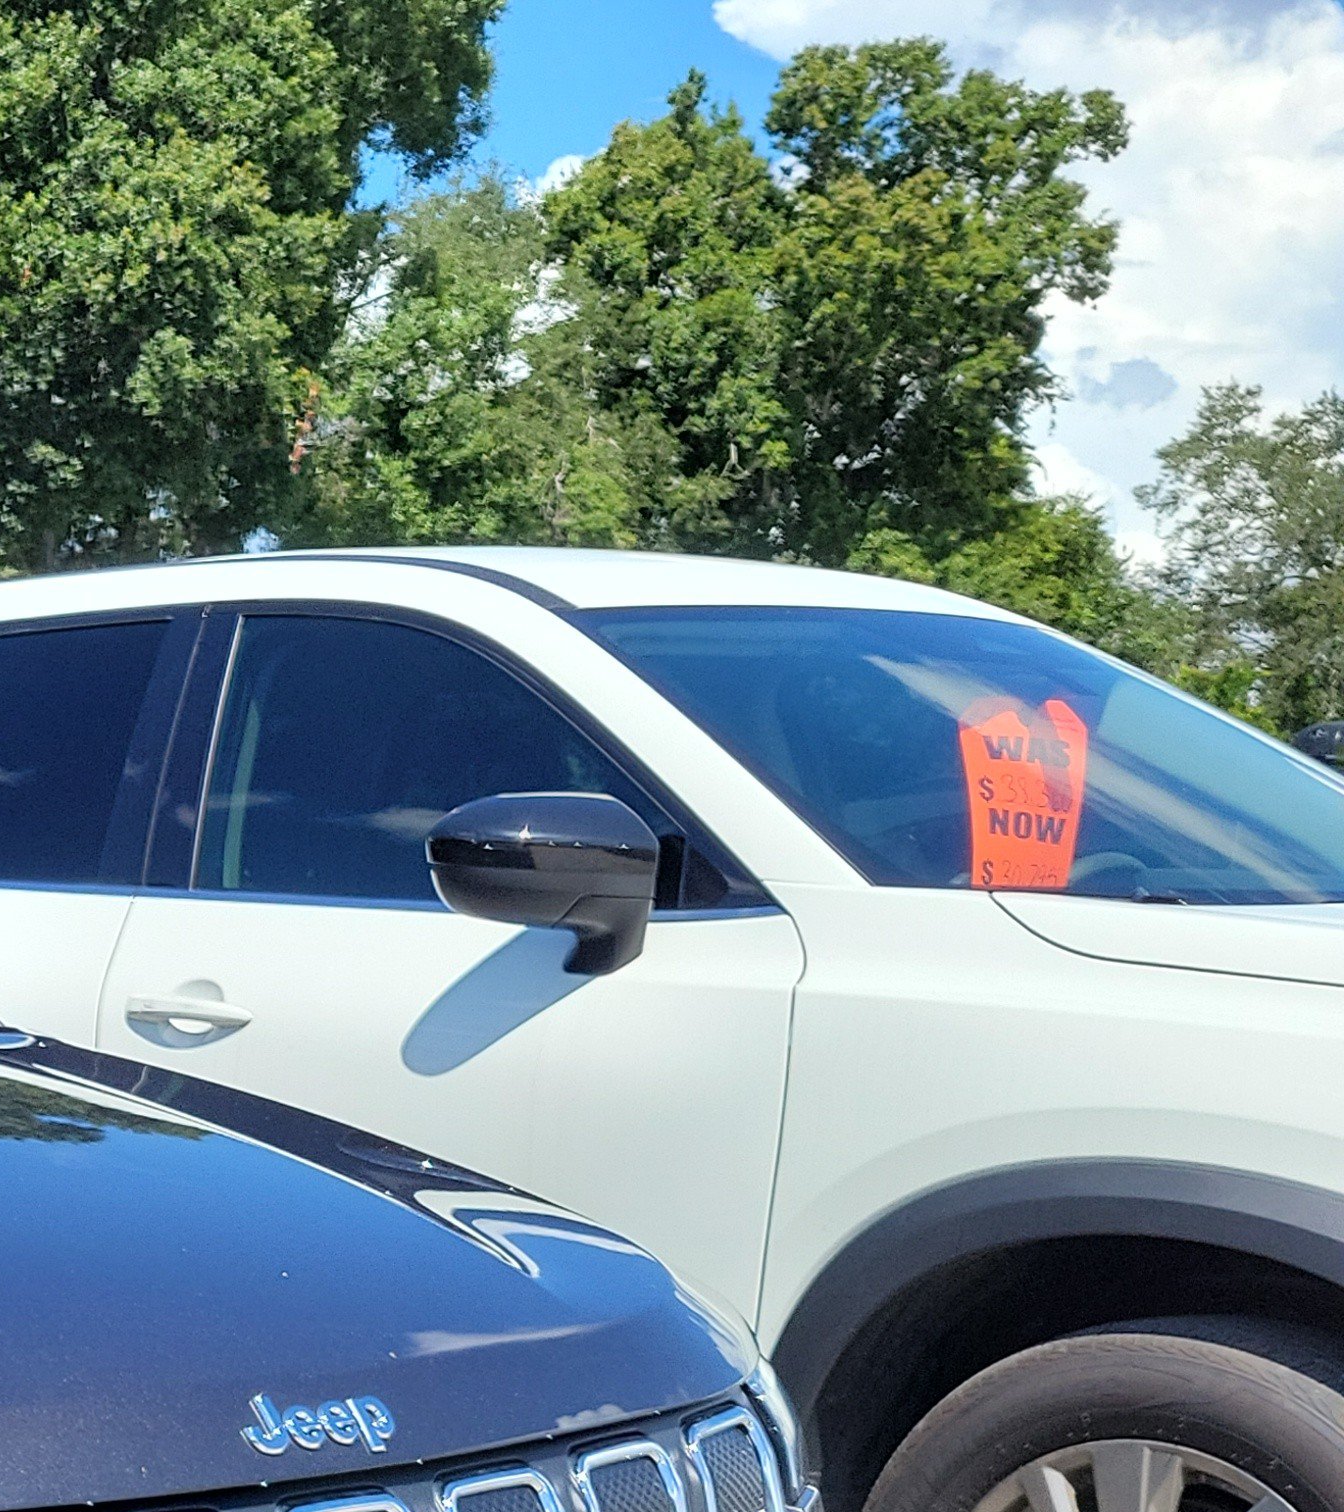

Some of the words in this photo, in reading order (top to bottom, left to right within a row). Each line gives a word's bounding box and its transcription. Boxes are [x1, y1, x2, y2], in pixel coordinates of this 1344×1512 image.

[983, 735, 1070, 768] WAS
[989, 808, 1067, 845] NOW
[239, 1392, 396, 1456] Jeep
